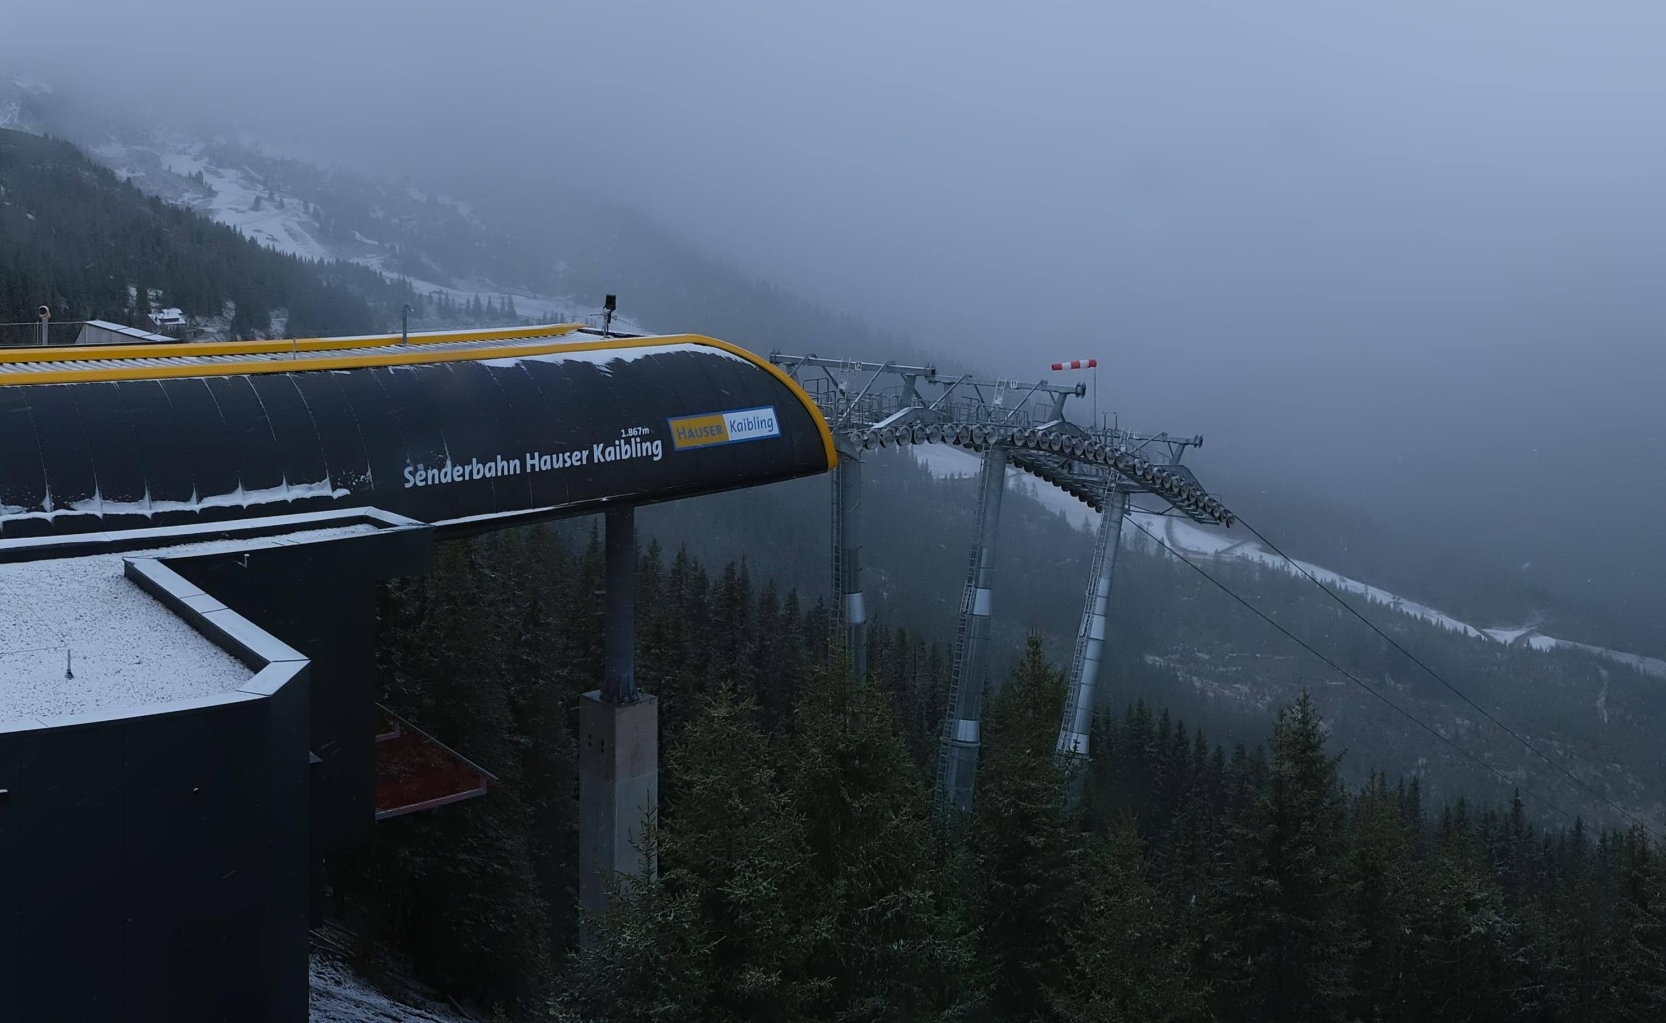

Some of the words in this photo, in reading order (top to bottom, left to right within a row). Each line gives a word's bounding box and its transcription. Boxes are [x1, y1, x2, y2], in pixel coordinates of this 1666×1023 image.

[620, 427, 650, 438] 1.867m
[676, 423, 723, 440] HAUSER
[729, 415, 774, 433] Kaibling
[404, 454, 521, 489] Senderbahn
[526, 448, 589, 472] Hauser
[593, 437, 663, 463] Kaibling
